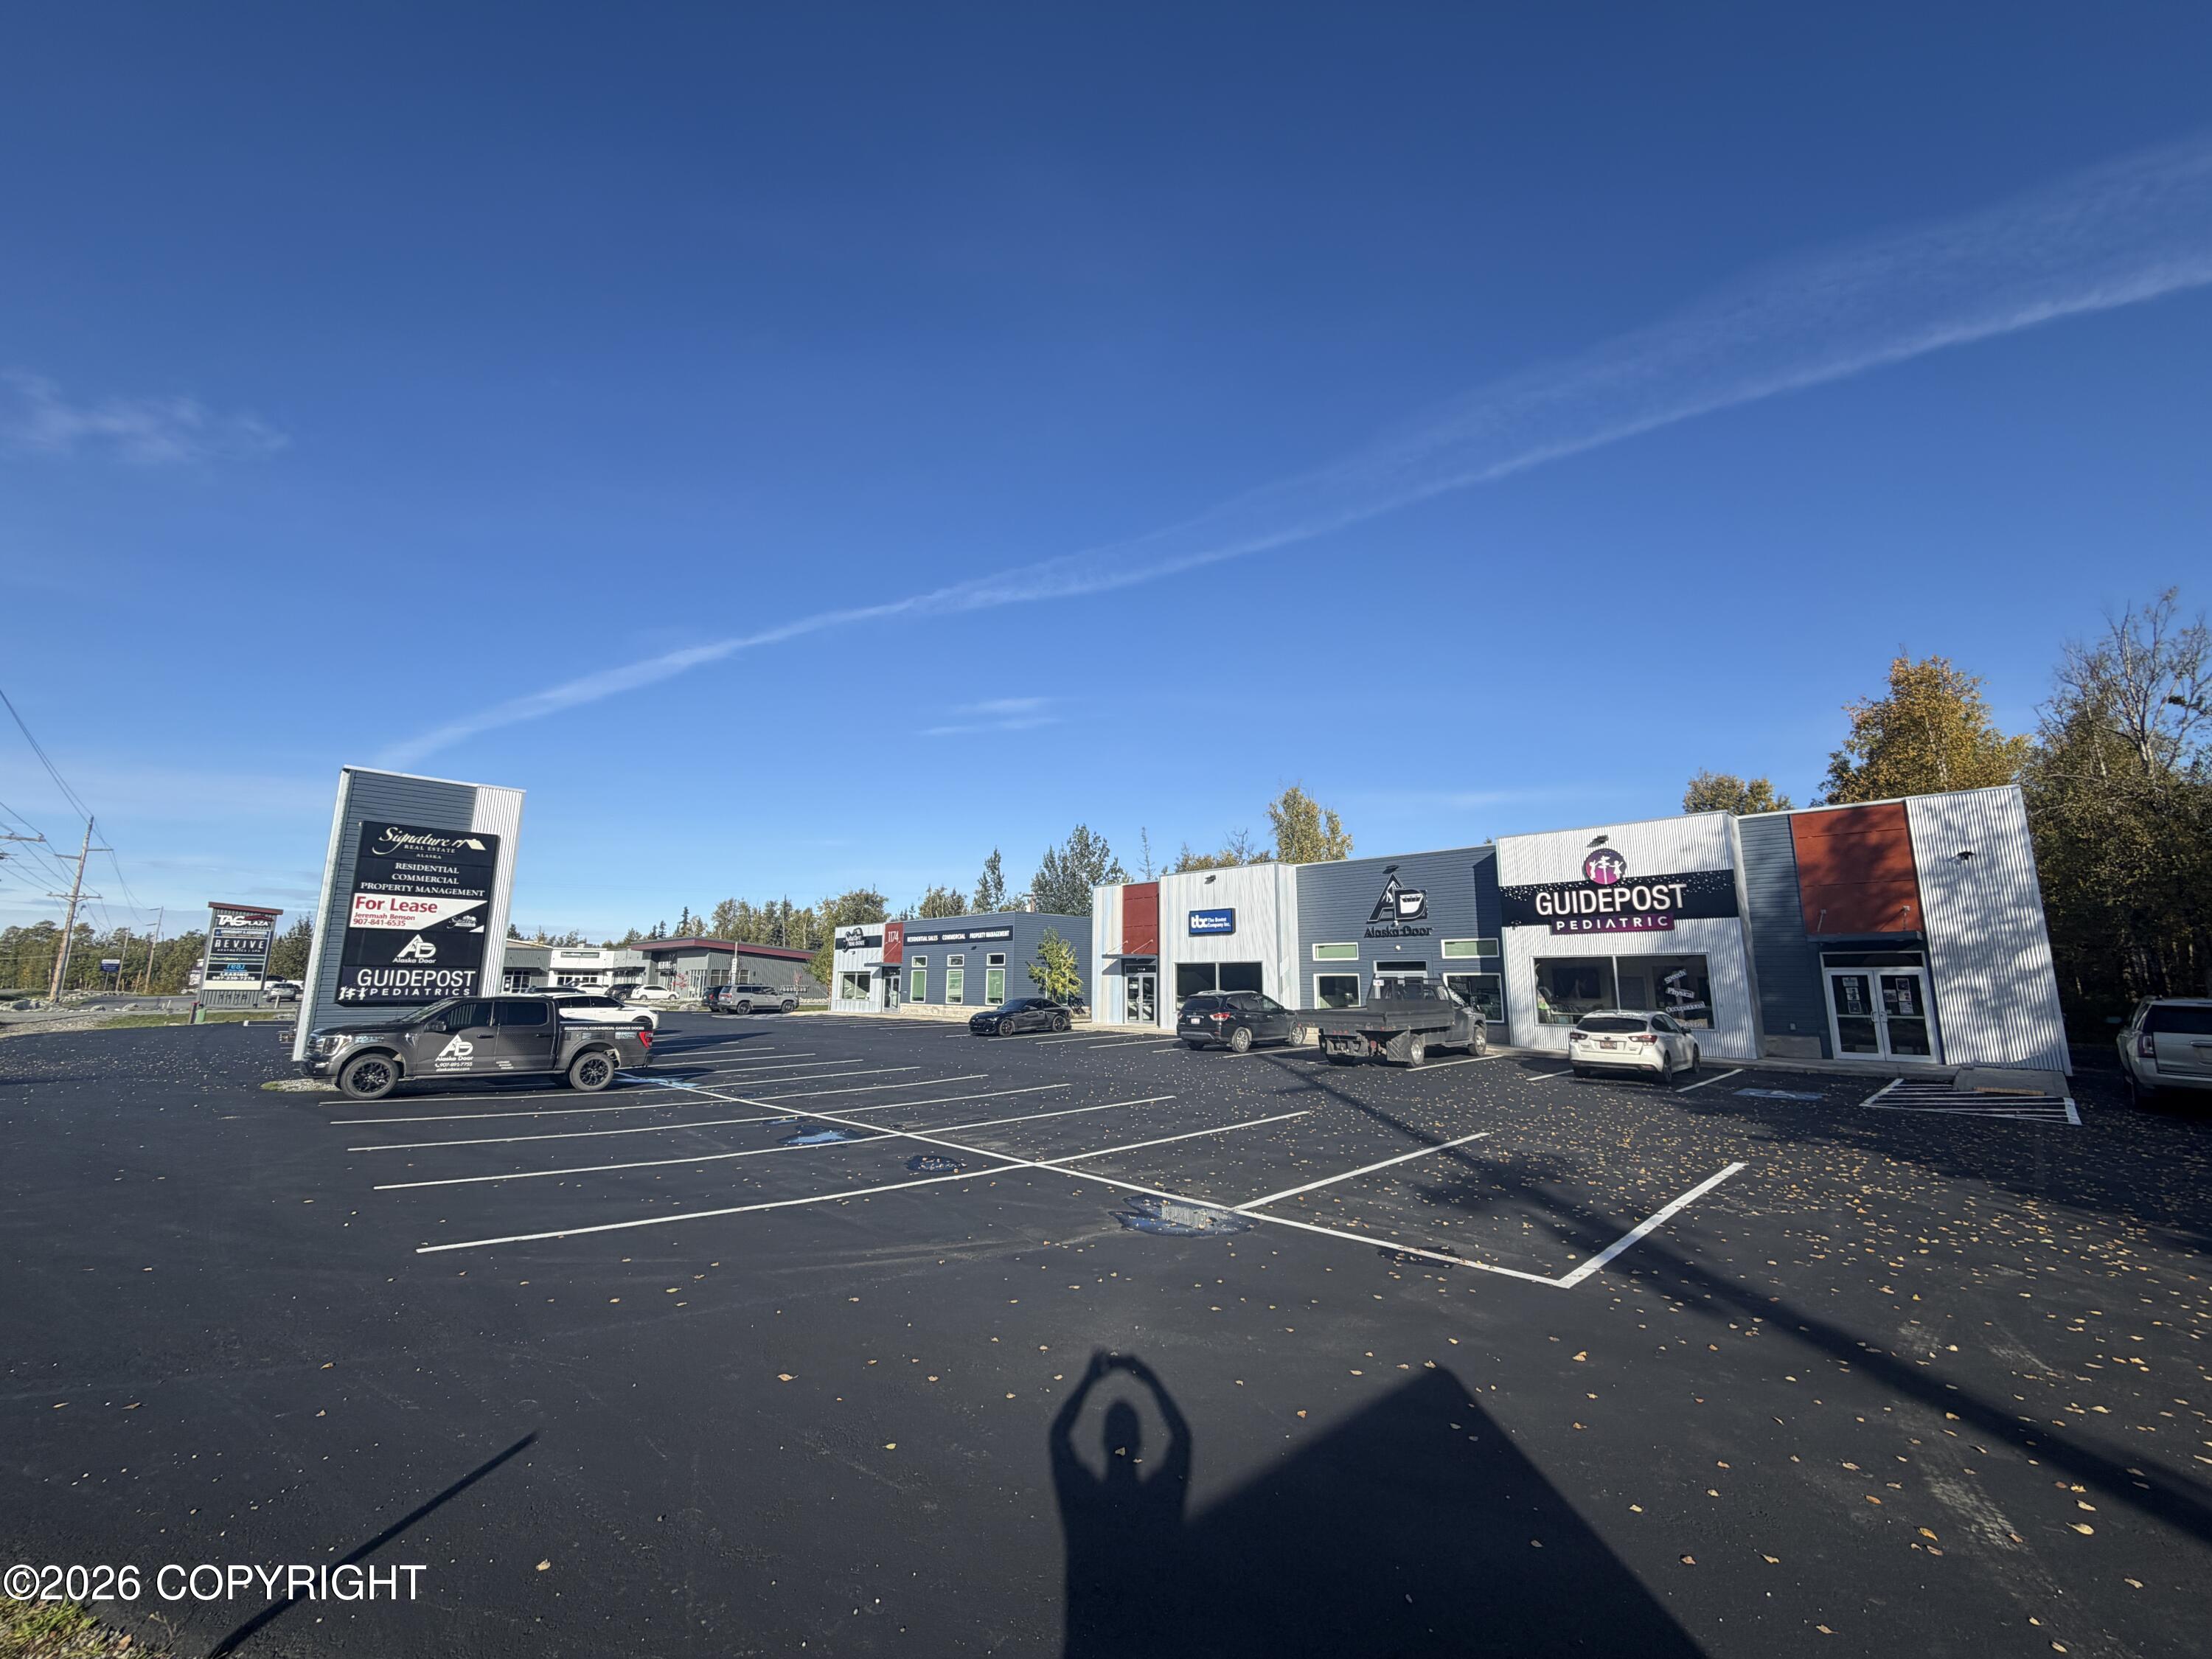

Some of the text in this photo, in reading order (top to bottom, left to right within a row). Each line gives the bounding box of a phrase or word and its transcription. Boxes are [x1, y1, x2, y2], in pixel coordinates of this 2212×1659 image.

[372, 827, 452, 855] Signature
[394, 862, 460, 874] RESIDENTIAL
[392, 873, 460, 885] COMMERCIAL
[361, 882, 486, 897] PROPERTY MANAGEMENT
[355, 896, 438, 914] For Lease
[1535, 883, 1687, 916] GUIDEPOST
[217, 914, 246, 926] TAG
[354, 912, 388, 920] Jeremiah
[353, 918, 406, 927] 907-841-6535
[1556, 916, 1669, 931] PEDIATRIC
[888, 931, 899, 943] 1174
[942, 933, 966, 941] COMMERCIAL
[969, 931, 986, 939] PROPERTY
[985, 930, 1010, 938] MANAGEMENT
[1364, 925, 1433, 939] Alaska Door
[215, 939, 265, 949] REVIVE
[357, 968, 476, 987] GUIDEPOST
[1666, 1001, 1705, 1014] Occupational
